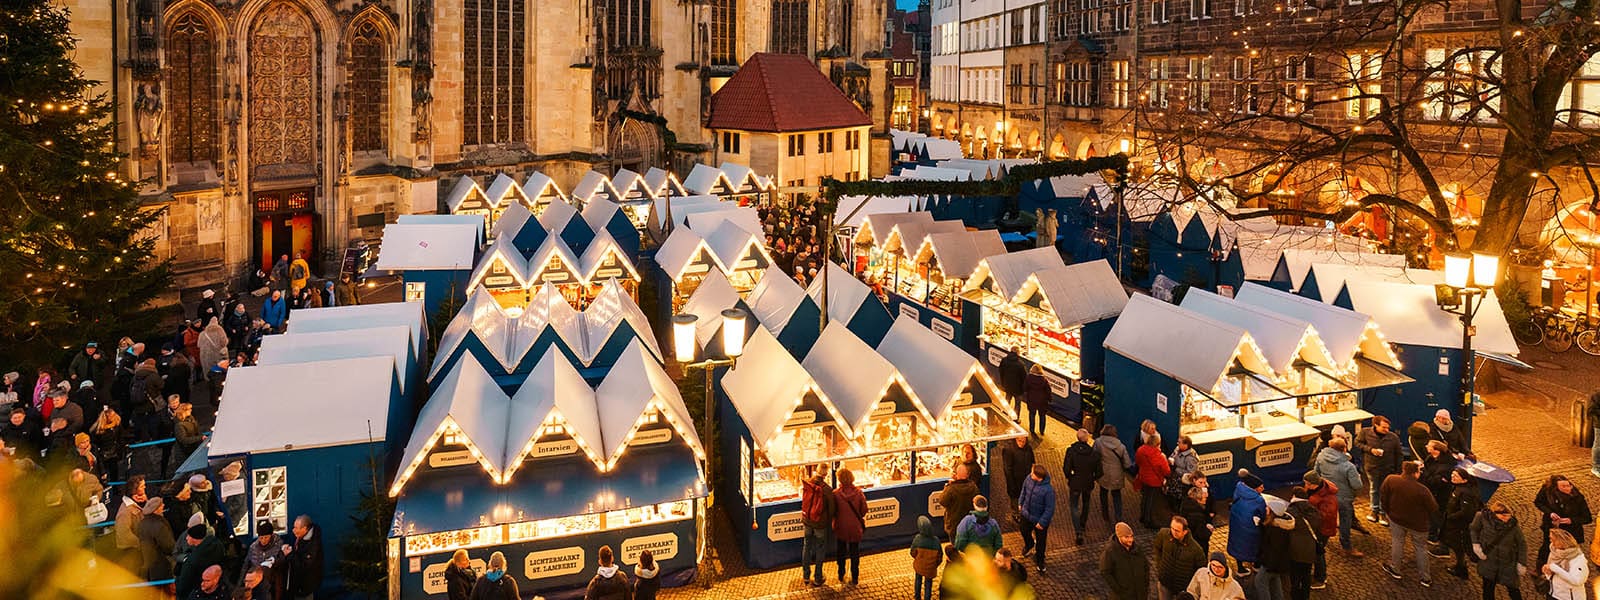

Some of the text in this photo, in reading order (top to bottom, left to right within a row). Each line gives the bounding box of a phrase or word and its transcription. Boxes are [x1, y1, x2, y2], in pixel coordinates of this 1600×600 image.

[538, 444, 571, 453] Intarsien
[1260, 446, 1291, 456] LICHTERMARKT
[626, 539, 674, 552] LICHTERMARKT
[529, 554, 580, 566] LICHTERMARKT
[543, 562, 577, 572] LAMBERTI
